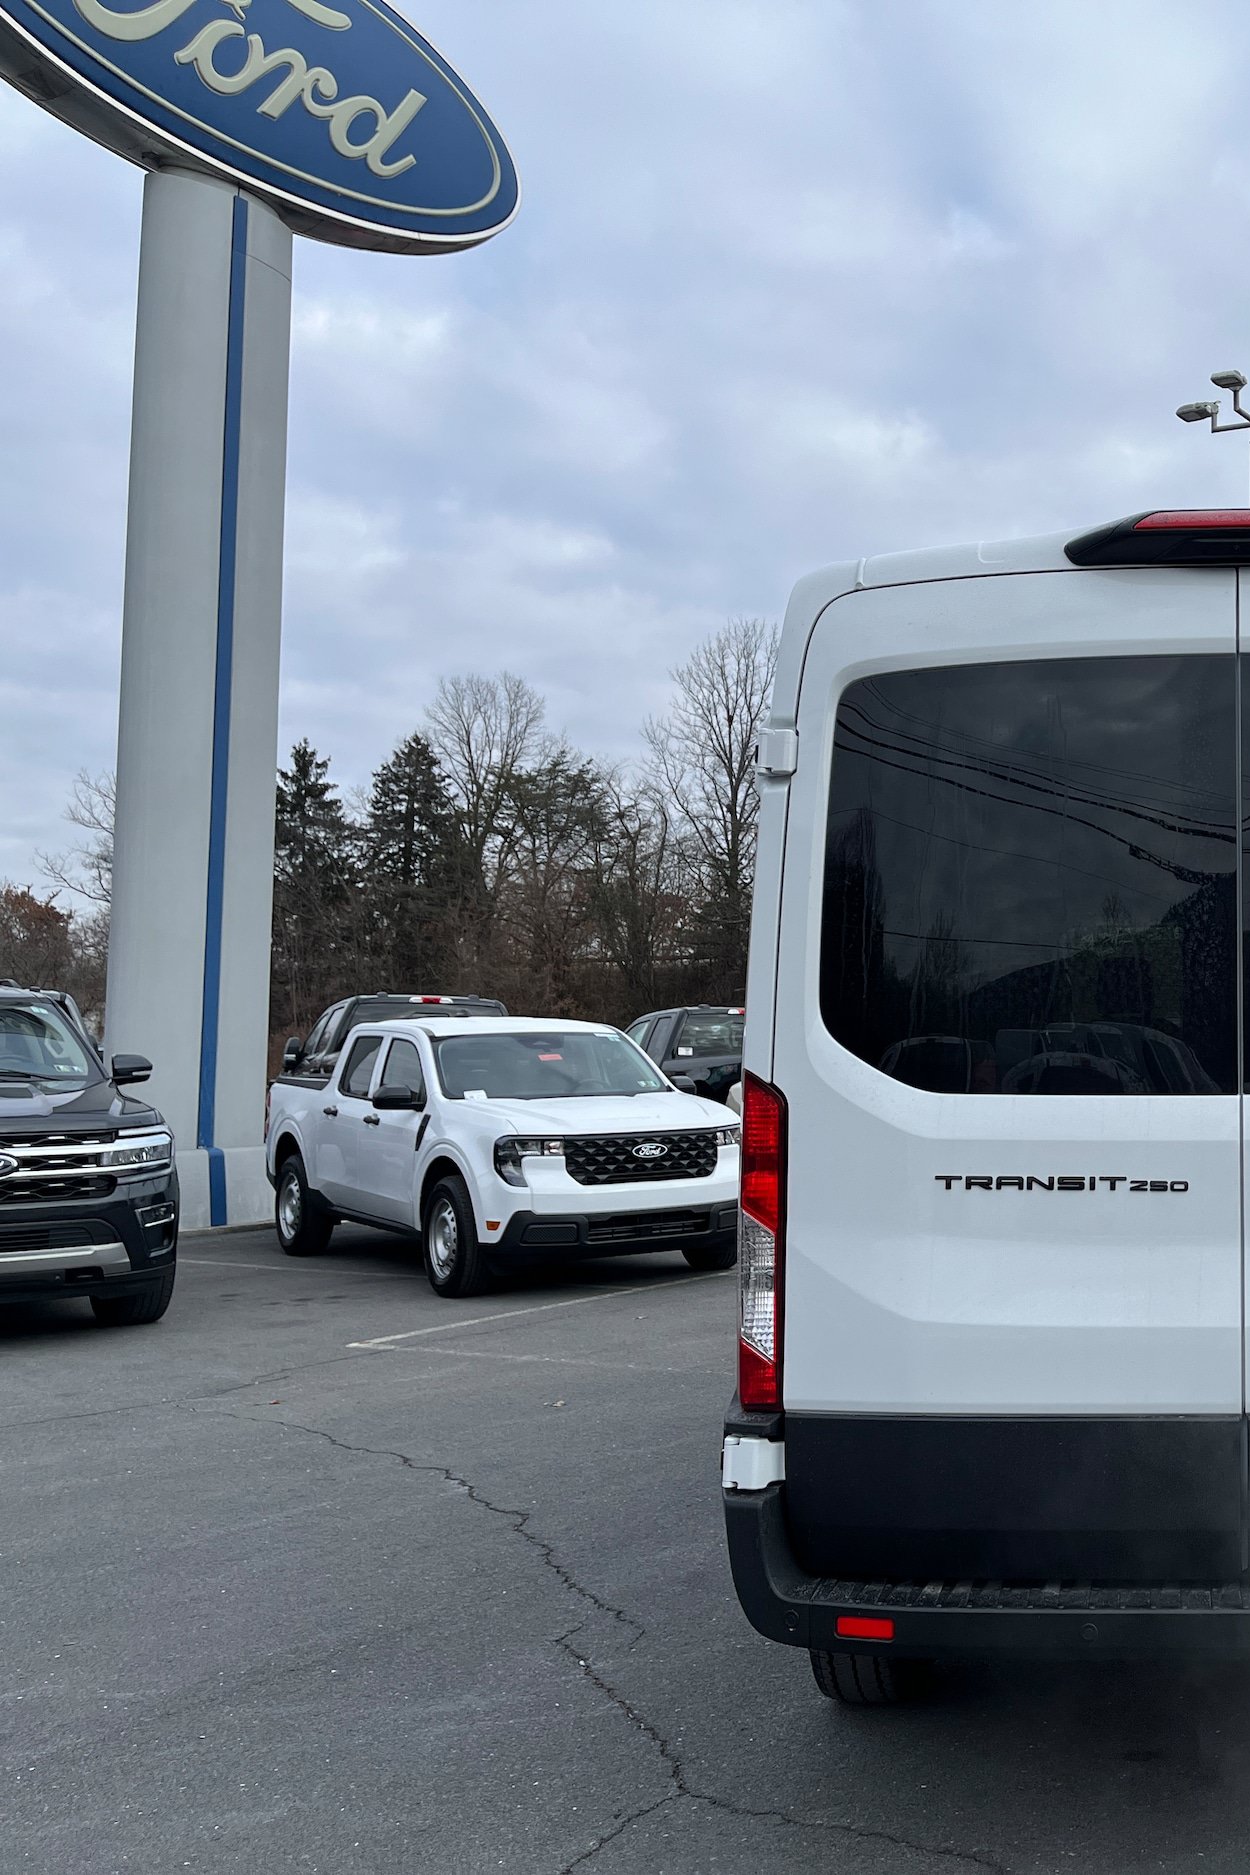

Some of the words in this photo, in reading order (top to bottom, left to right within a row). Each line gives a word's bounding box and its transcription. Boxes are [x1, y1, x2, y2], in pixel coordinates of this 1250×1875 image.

[639, 1145, 661, 1156] Ford
[935, 1175, 1127, 1191] TRANSIT
[1129, 1180, 1189, 1192] 250
